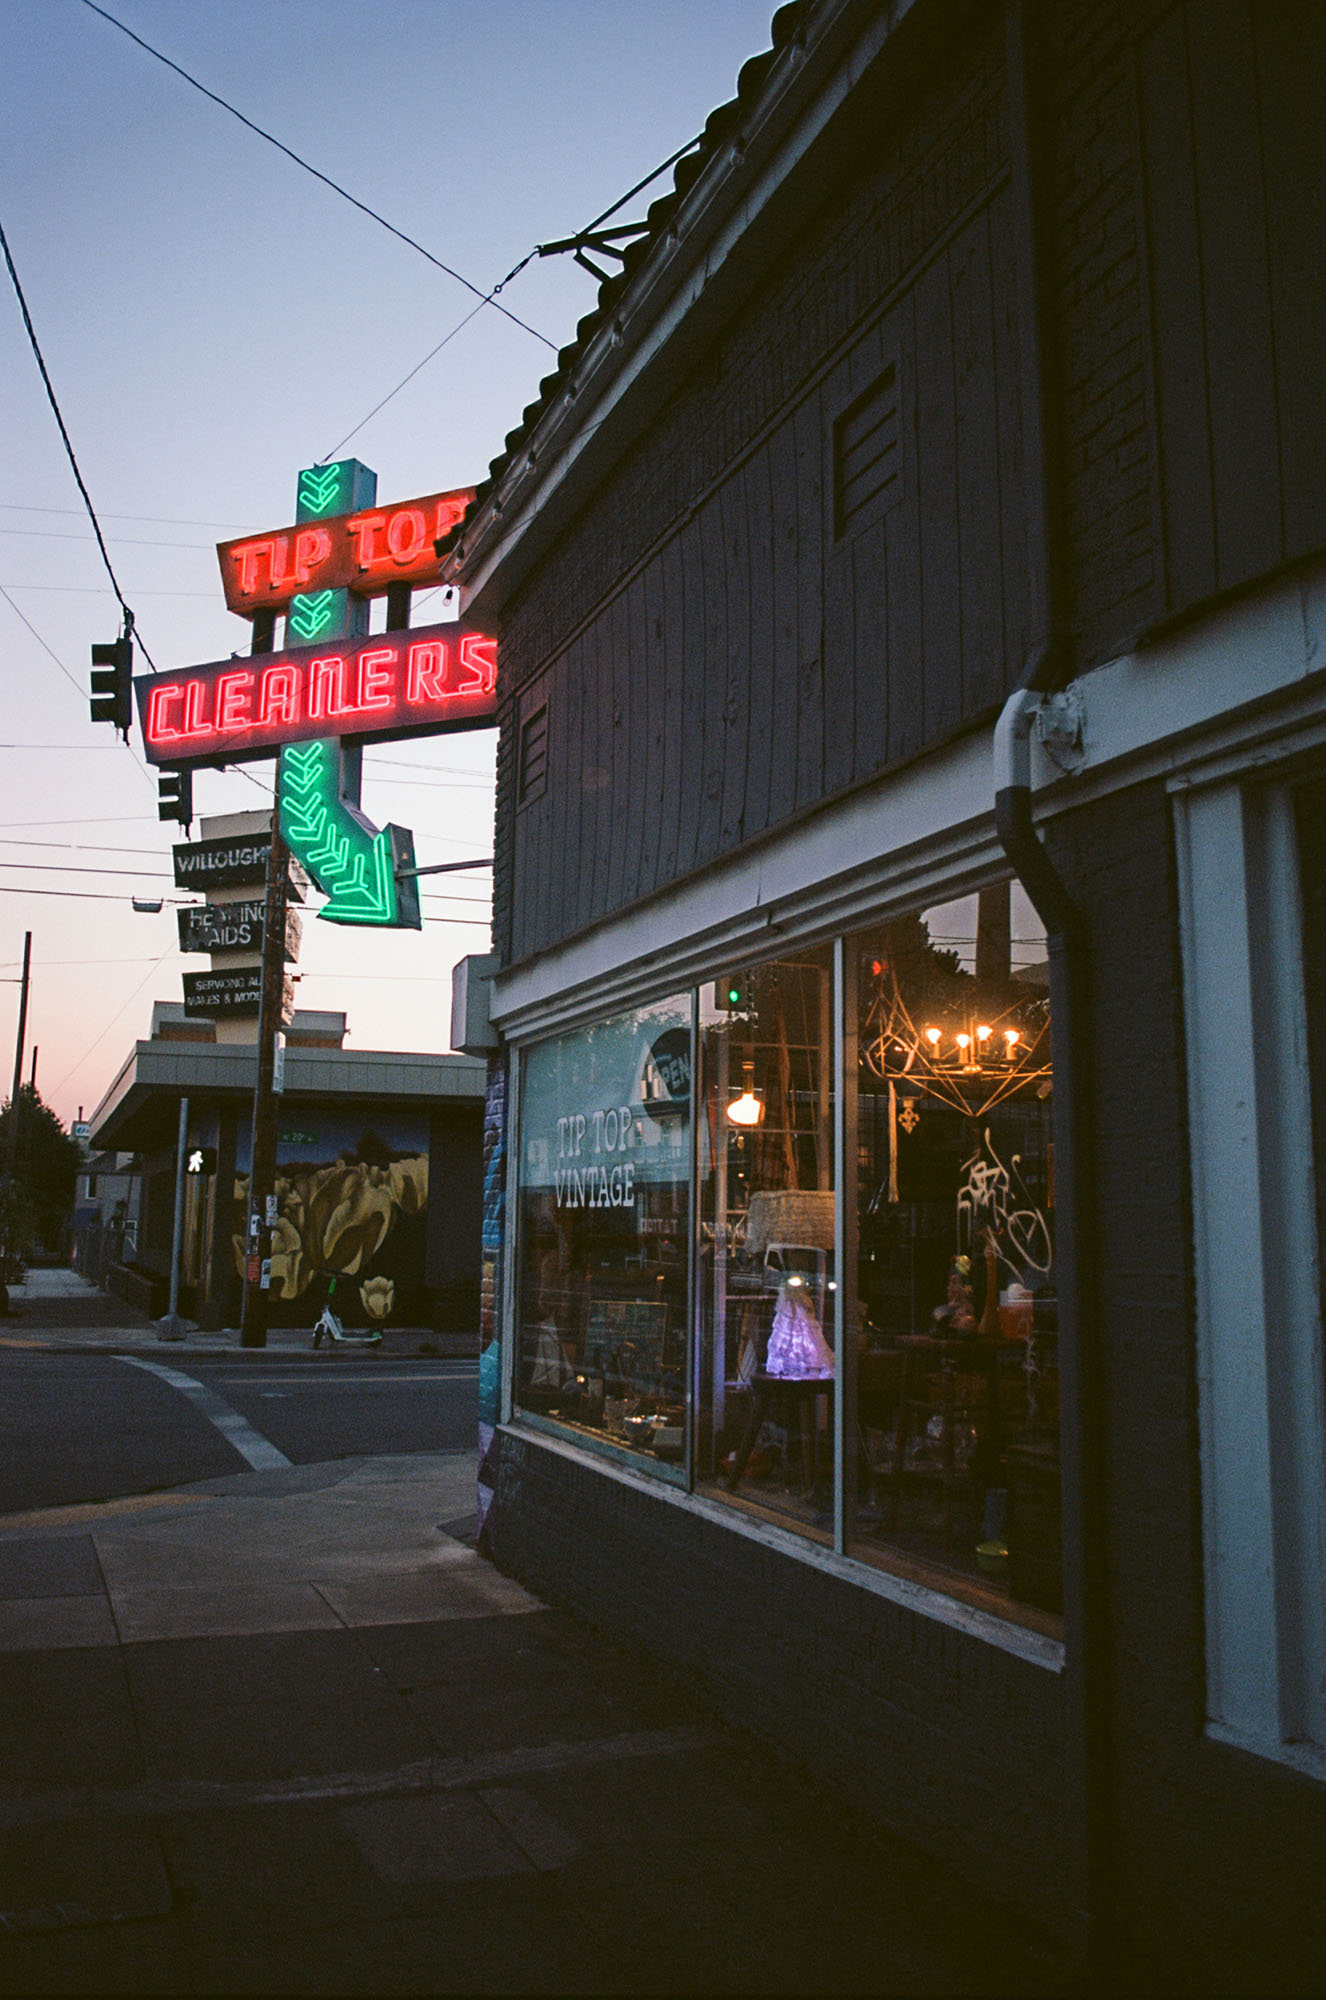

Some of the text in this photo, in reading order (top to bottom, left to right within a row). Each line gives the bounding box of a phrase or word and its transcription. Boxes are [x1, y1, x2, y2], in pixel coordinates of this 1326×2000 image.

[230, 500, 468, 595] TIP TOP
[148, 635, 497, 742] CLEANERS
[177, 846, 271, 872] WILLOUGH
[195, 975, 261, 991] SERVICING AL
[234, 990, 261, 1003] MODE
[660, 1053, 690, 1090] PEN
[557, 1107, 632, 1158] TIP TOP
[553, 1163, 635, 1208] VINTAGE
